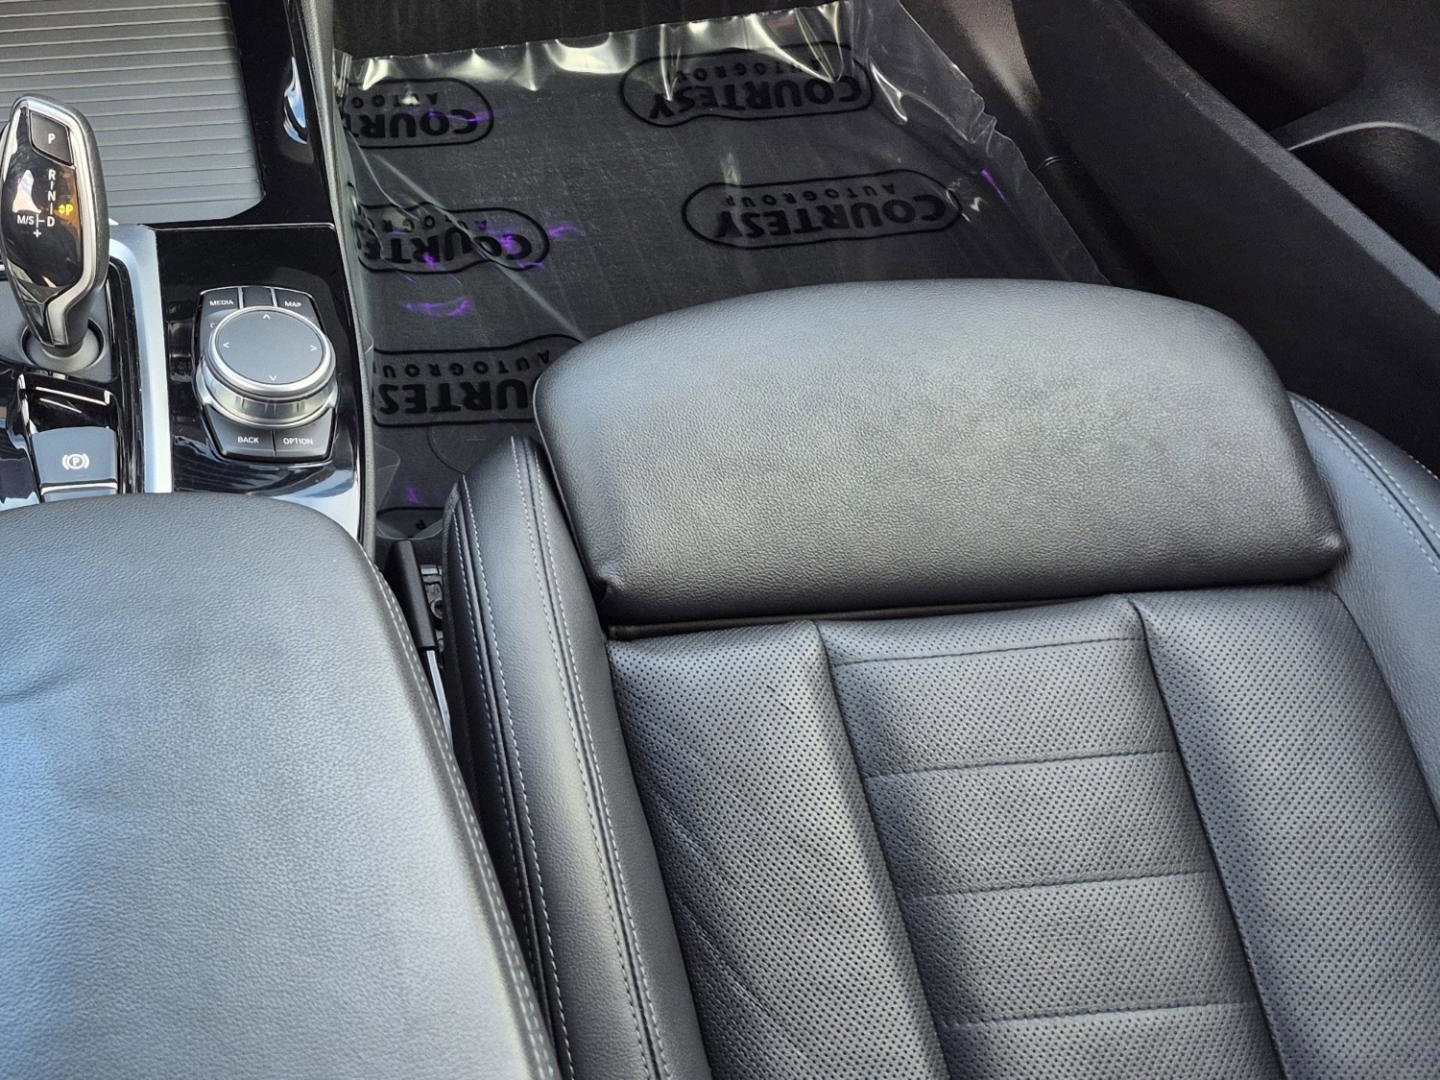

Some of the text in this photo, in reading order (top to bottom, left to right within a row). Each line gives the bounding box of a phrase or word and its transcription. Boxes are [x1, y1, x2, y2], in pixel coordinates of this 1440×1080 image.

[47, 132, 56, 144] P
[48, 168, 57, 180] R
[47, 190, 57, 202] N
[16, 215, 56, 227] M/S D
[712, 193, 947, 239] COURTESY
[209, 299, 234, 307] MEDIA
[284, 300, 302, 308] MAP
[237, 436, 260, 444] BACK
[282, 436, 314, 446] OPTION
